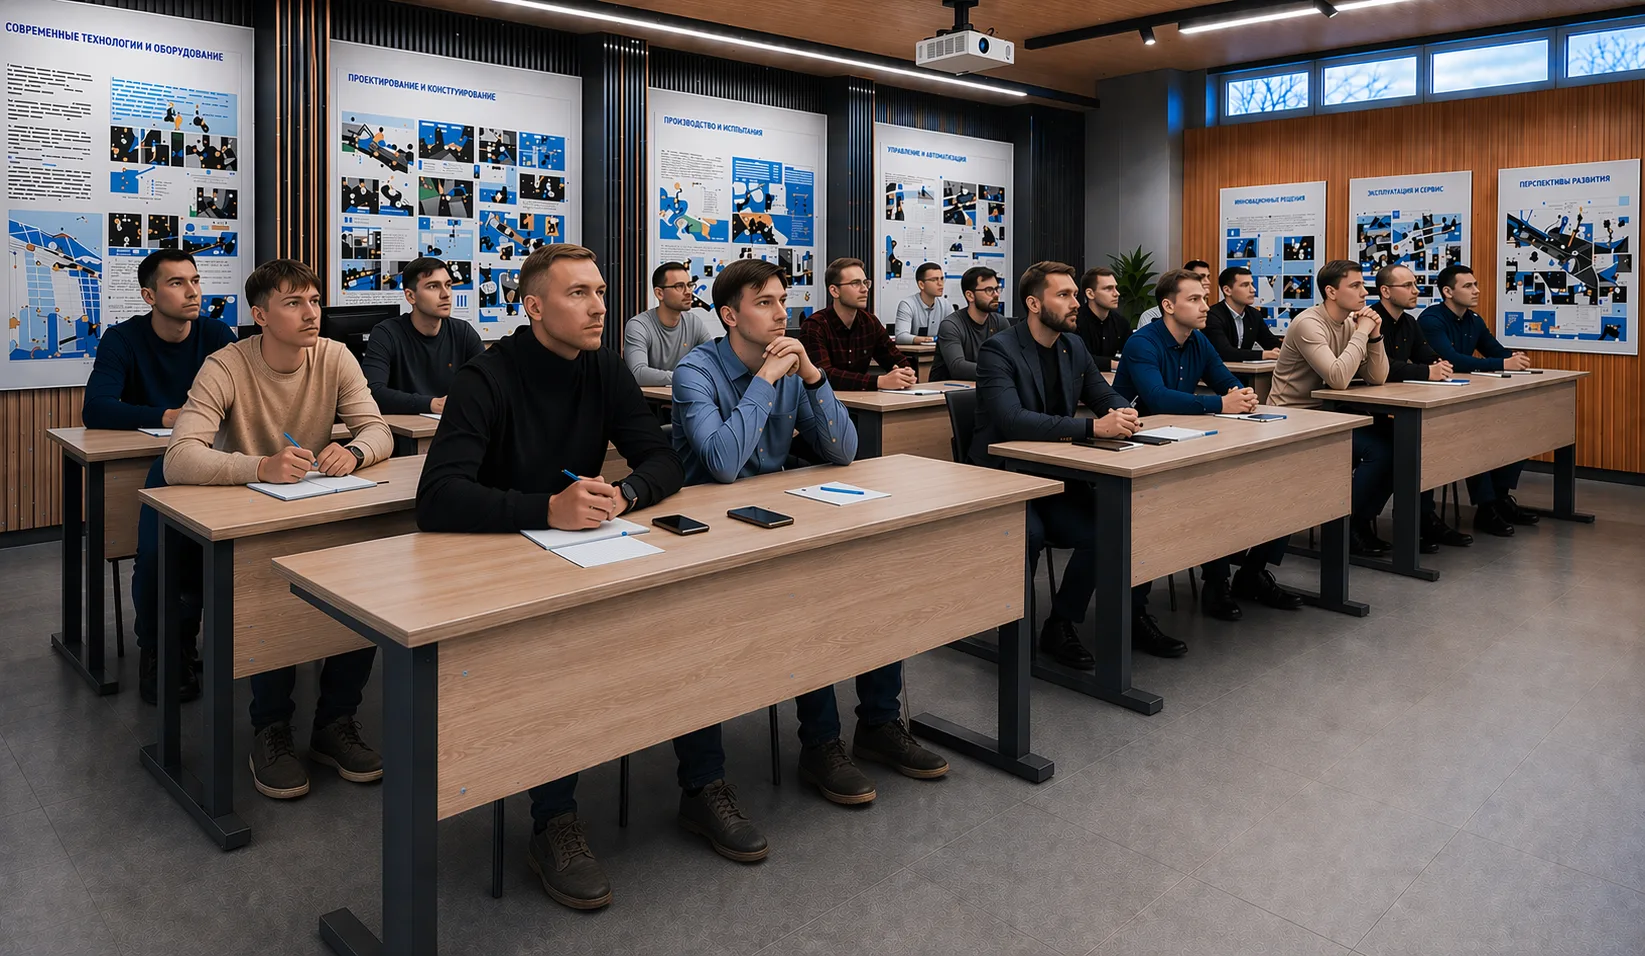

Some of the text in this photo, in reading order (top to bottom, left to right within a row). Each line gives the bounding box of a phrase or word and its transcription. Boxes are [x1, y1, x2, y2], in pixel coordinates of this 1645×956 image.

[5, 21, 224, 62] СОВРЕМЕННЫЕ ТЕХНОЛОГИИ И ОБОРУДОВАНИЕ
[348, 73, 420, 91] ПРОЕКТИРОВАНИЕ
[420, 83, 426, 92] И
[716, 123, 722, 131] И
[1519, 174, 1611, 188] ПЕРСПЕКТИВЫ РАЗВИТИЯ
